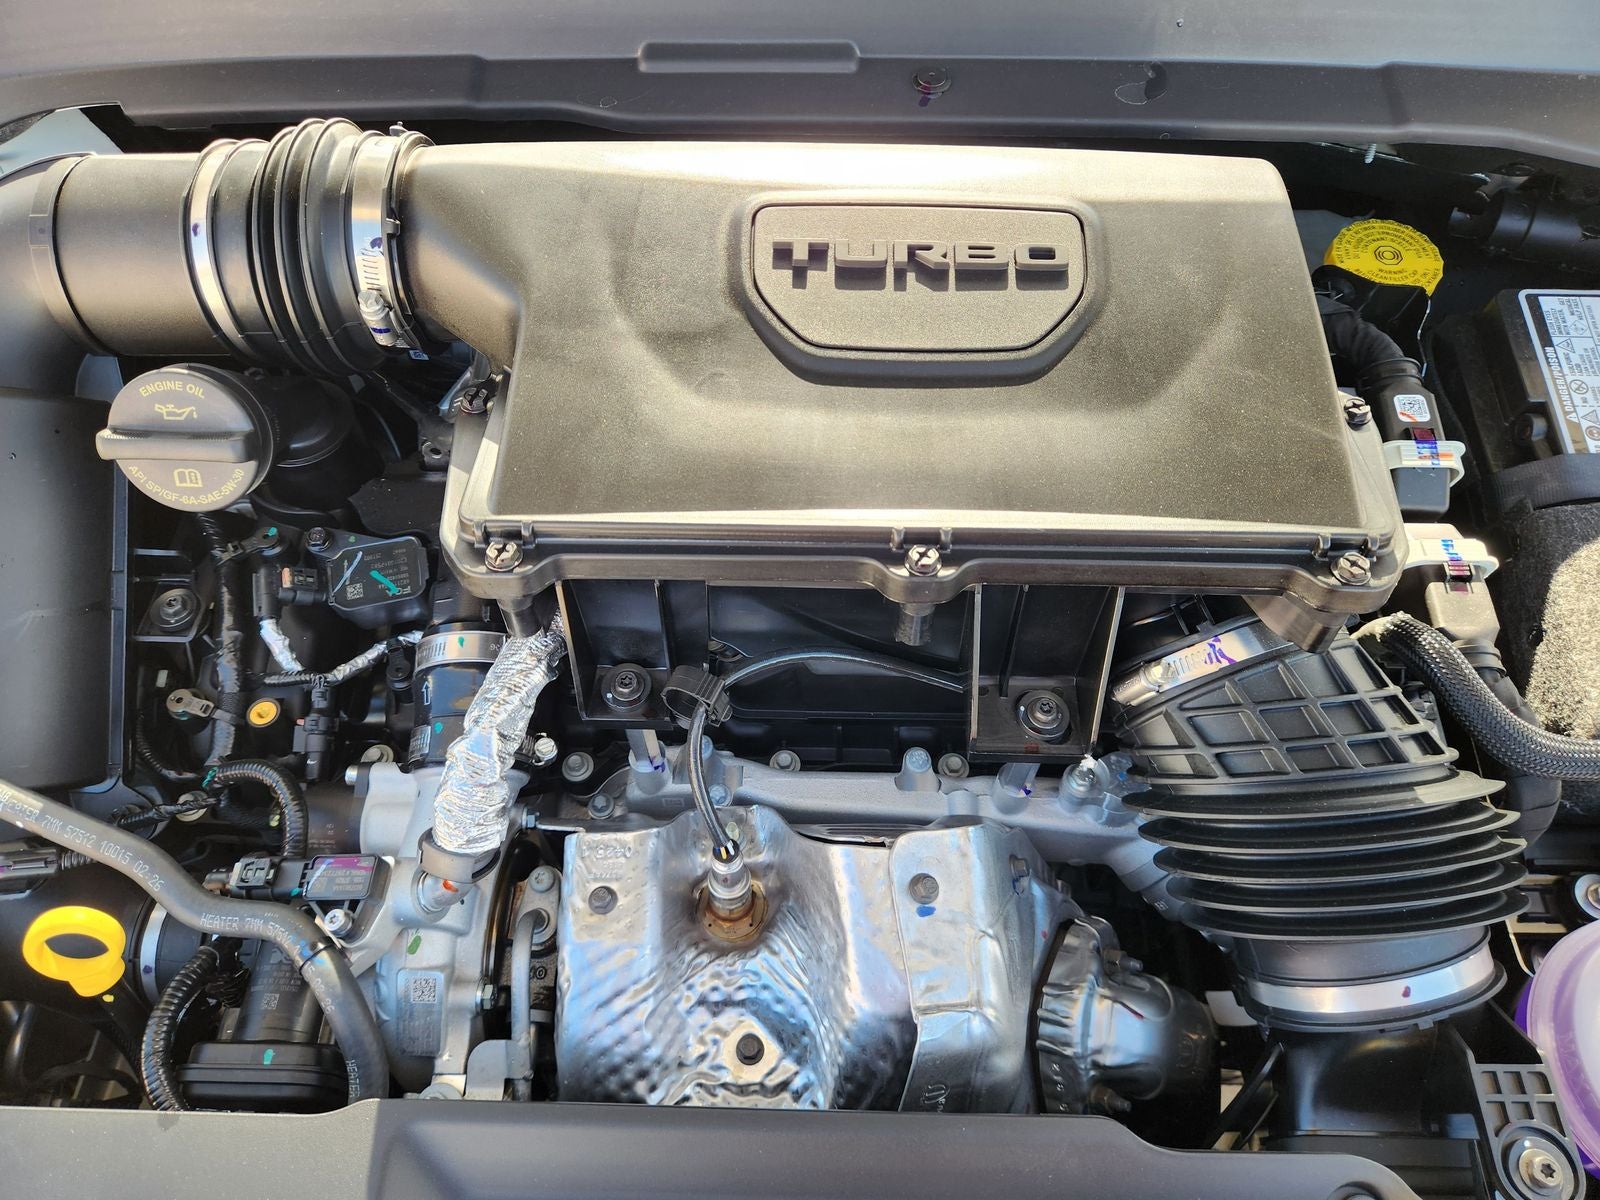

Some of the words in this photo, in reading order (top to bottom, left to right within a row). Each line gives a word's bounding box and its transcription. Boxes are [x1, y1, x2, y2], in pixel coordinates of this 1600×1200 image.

[772, 238, 1070, 272] TURBO
[140, 381, 183, 398] ENGINE
[186, 384, 205, 399] OIL
[1544, 346, 1575, 411] DANGER/POISON
[129, 465, 147, 483] API
[100, 840, 134, 866] 10015
[200, 912, 240, 931] HEATER
[244, 916, 265, 935] 7MM
[346, 1059, 361, 1098] HEATER
